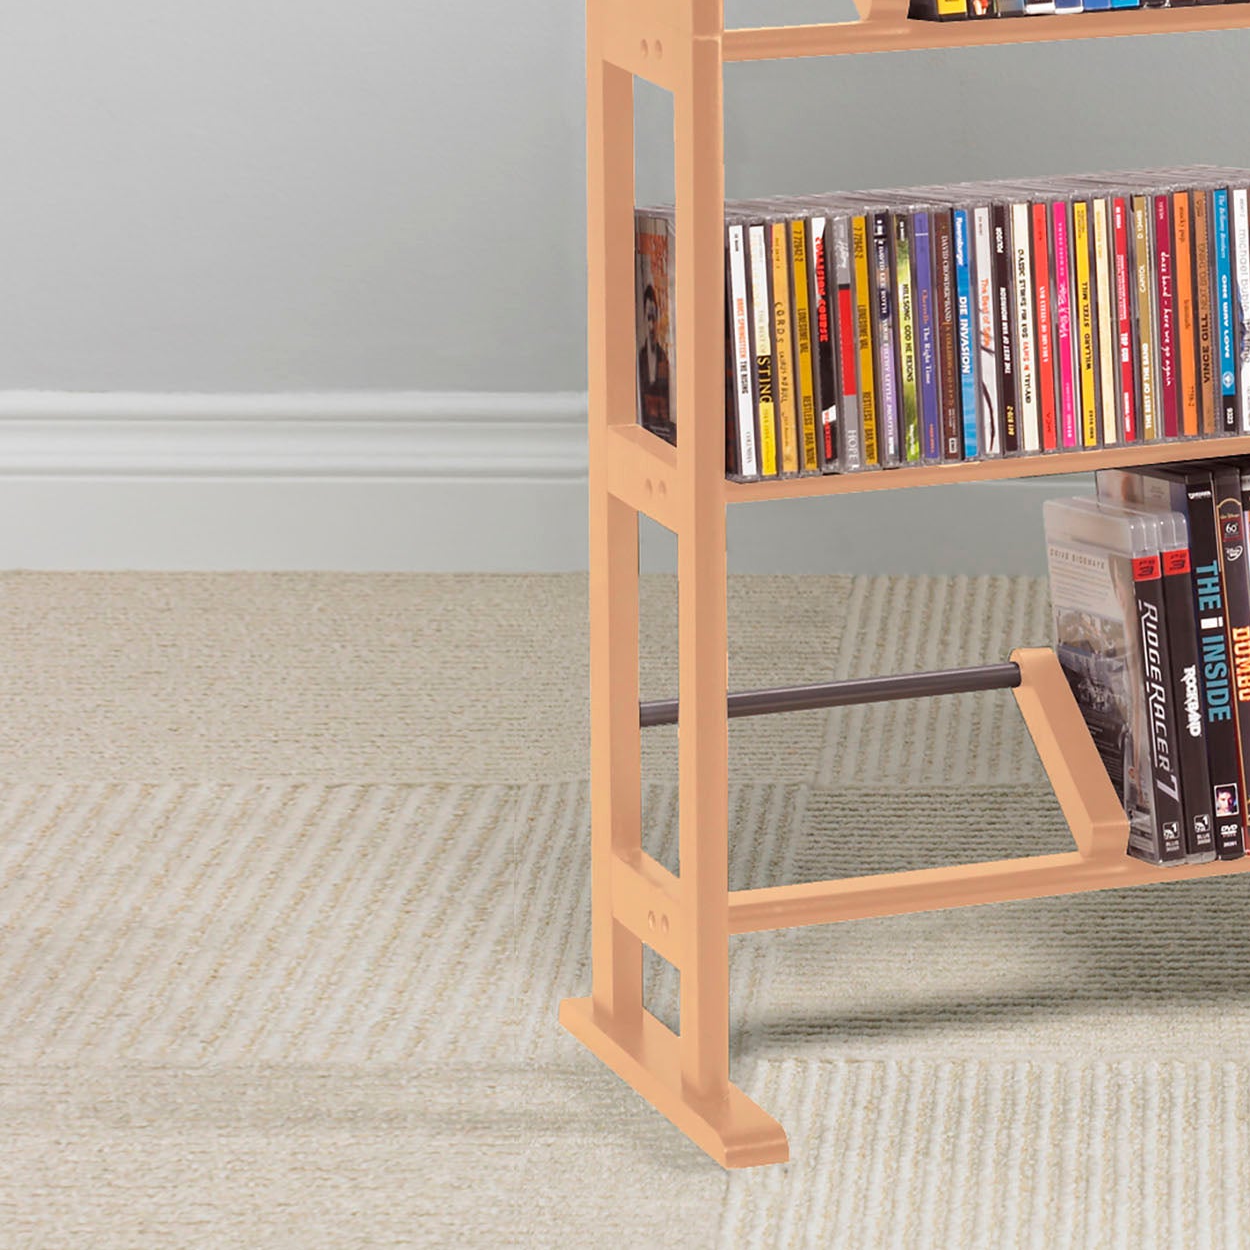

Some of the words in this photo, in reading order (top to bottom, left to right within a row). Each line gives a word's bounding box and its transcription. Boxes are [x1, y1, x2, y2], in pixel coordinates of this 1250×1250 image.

[956, 217, 965, 266] Ravensburger
[959, 296, 968, 315] DIE
[798, 308, 807, 340] LONESOME
[1200, 314, 1208, 341] GILL
[800, 342, 808, 353] VAL
[923, 342, 931, 363] Right
[961, 319, 970, 373] INVASION
[757, 357, 772, 403] STING
[1201, 346, 1210, 383] VINCE
[1144, 384, 1150, 393] OF
[1197, 561, 1220, 611] THE
[1203, 636, 1230, 722] INSIDE
[1156, 773, 1178, 801] 7
